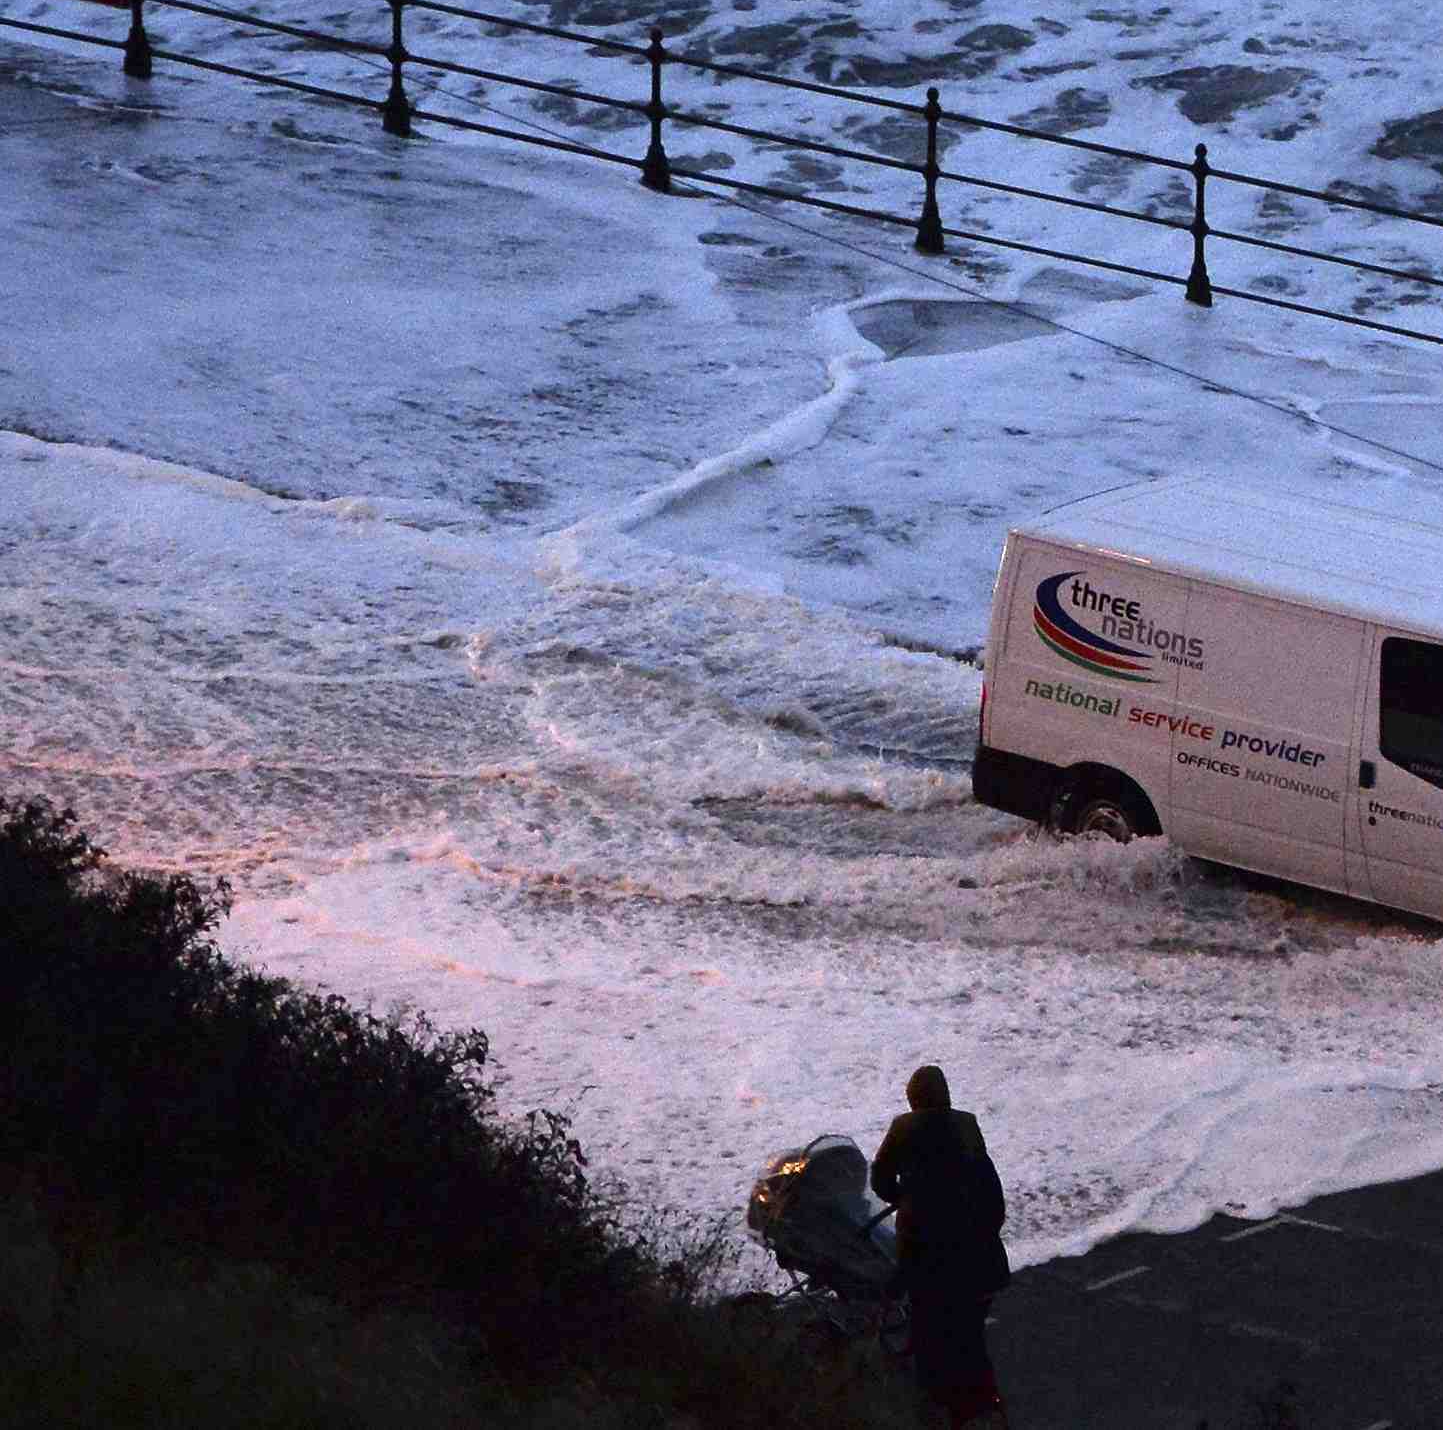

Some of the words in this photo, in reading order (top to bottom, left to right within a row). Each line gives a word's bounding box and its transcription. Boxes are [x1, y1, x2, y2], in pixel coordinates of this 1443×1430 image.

[1071, 579, 1141, 621] three
[1102, 615, 1203, 658] nations
[1162, 652, 1203, 671] limited
[1023, 678, 1120, 717] national
[1127, 706, 1215, 741] service
[1220, 727, 1326, 768] provider
[1176, 751, 1240, 778] OFFICES
[1244, 768, 1341, 803] NATIONWIDE
